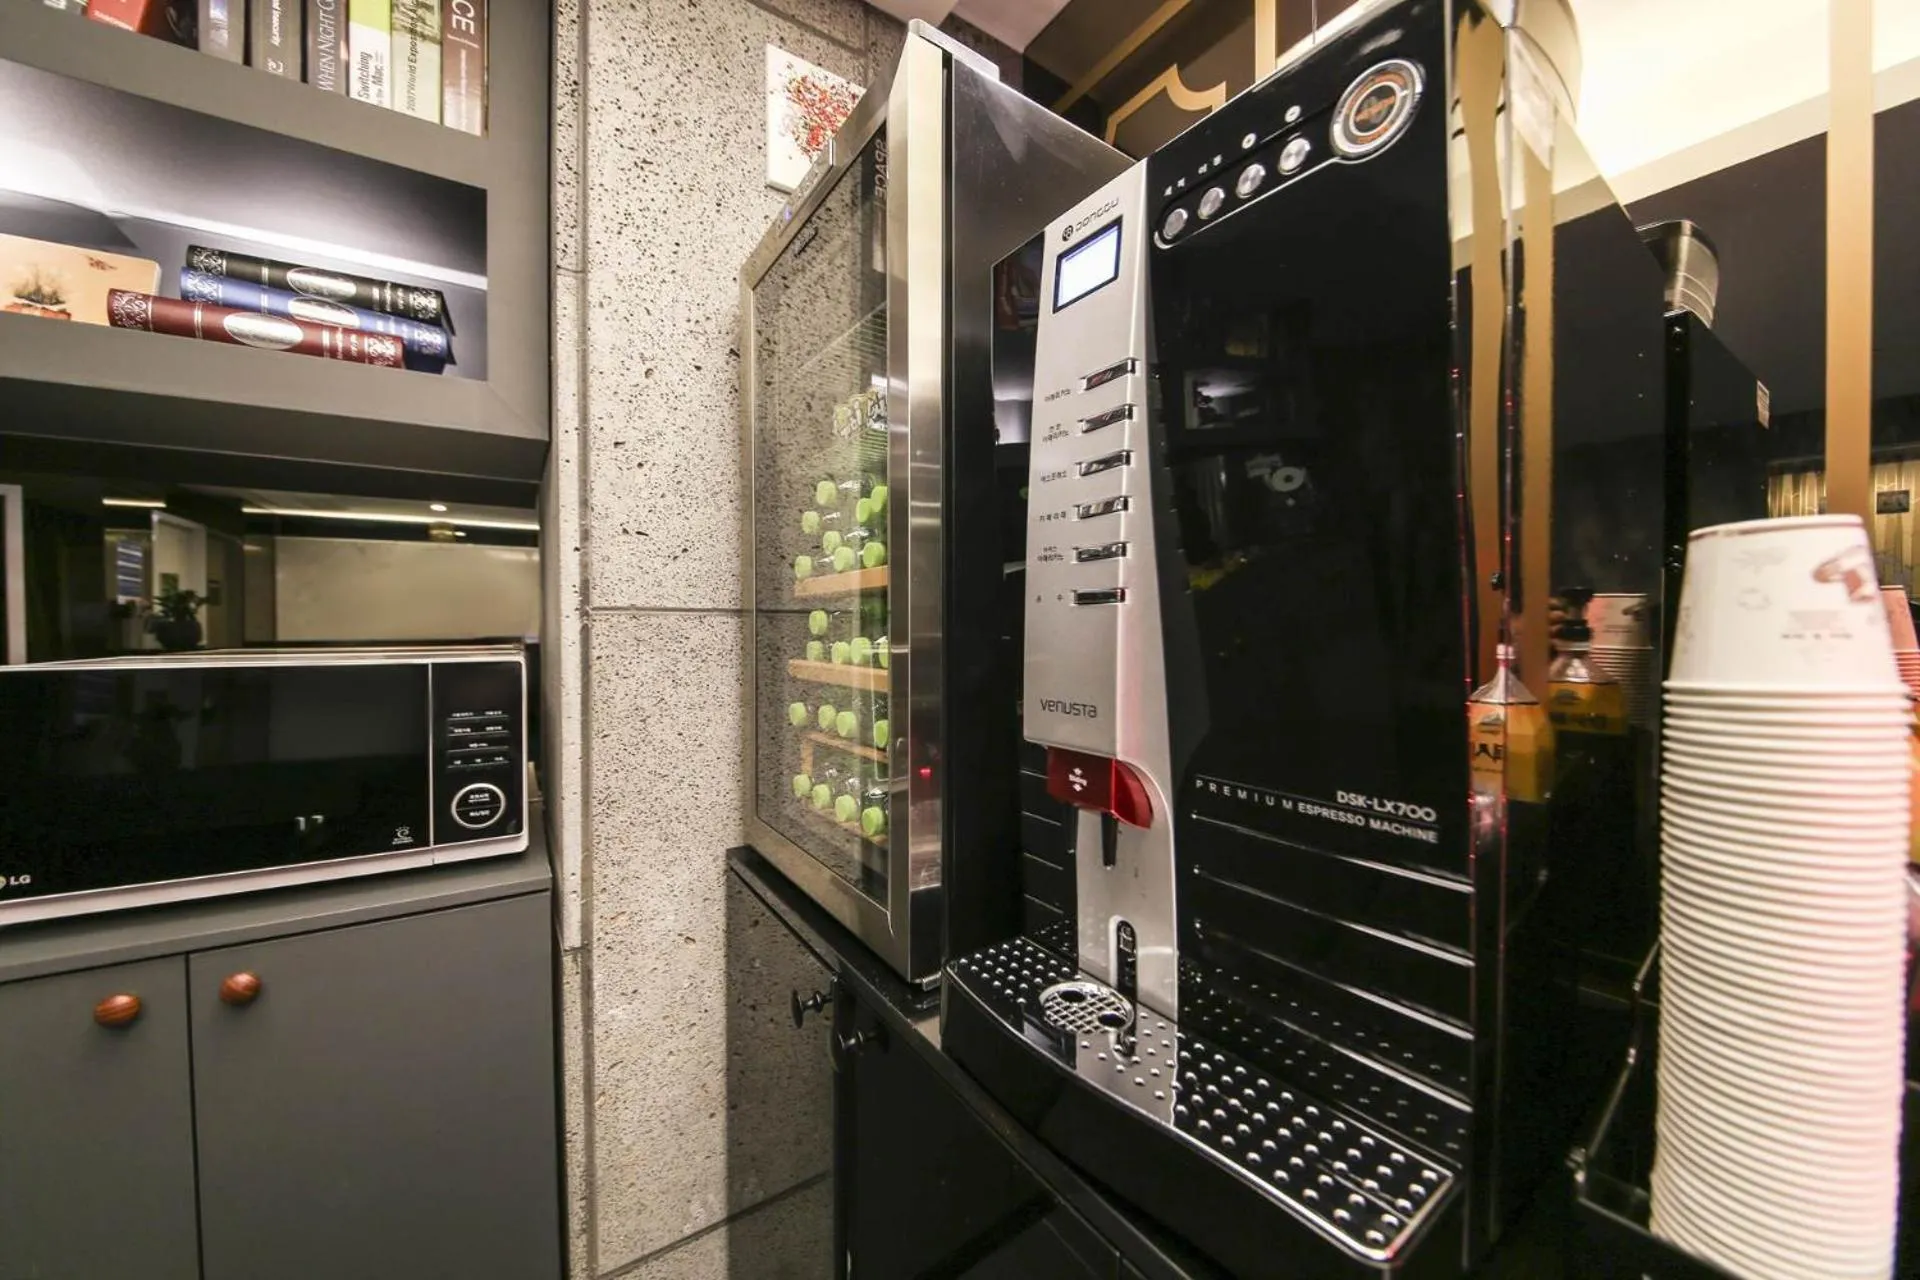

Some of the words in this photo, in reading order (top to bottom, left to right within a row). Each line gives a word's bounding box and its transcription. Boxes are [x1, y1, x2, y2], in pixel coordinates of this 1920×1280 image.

[317, 10, 335, 52] NIGHT
[317, 52, 335, 91] WHEN
[357, 51, 373, 99] Switching
[1196, 779, 1293, 810] PREMIUM
[1298, 801, 1366, 827] ESPRESSO
[1369, 817, 1440, 844] MACHINE
[1336, 789, 1437, 823] DSK-LX700
[9, 874, 32, 886] LG
